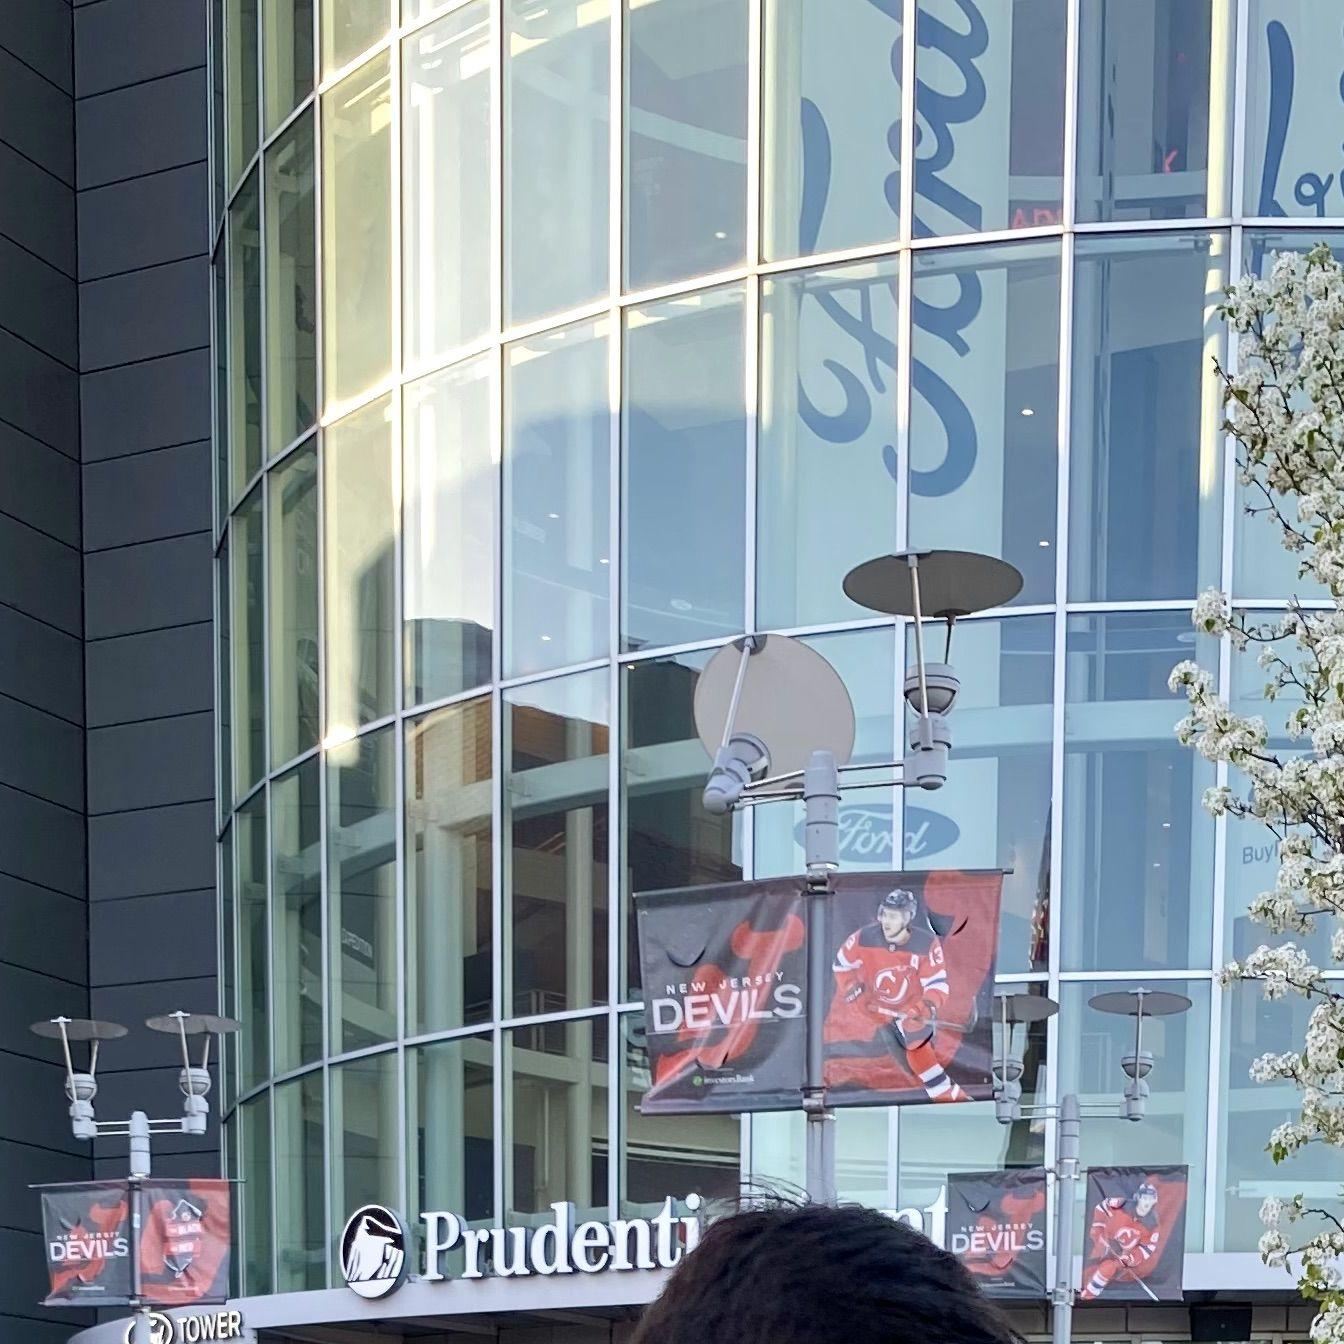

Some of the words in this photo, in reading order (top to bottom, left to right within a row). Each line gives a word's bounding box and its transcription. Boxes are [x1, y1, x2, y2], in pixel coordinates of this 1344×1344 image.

[665, 982, 706, 995] NEW
[719, 971, 785, 990] JERSEY
[652, 984, 804, 1033] DEVILS
[49, 1238, 129, 1261] DEVILS
[420, 1193, 704, 1281] Prudenti
[952, 1229, 1044, 1254] DEVILS
[176, 1310, 242, 1343] TOWER
